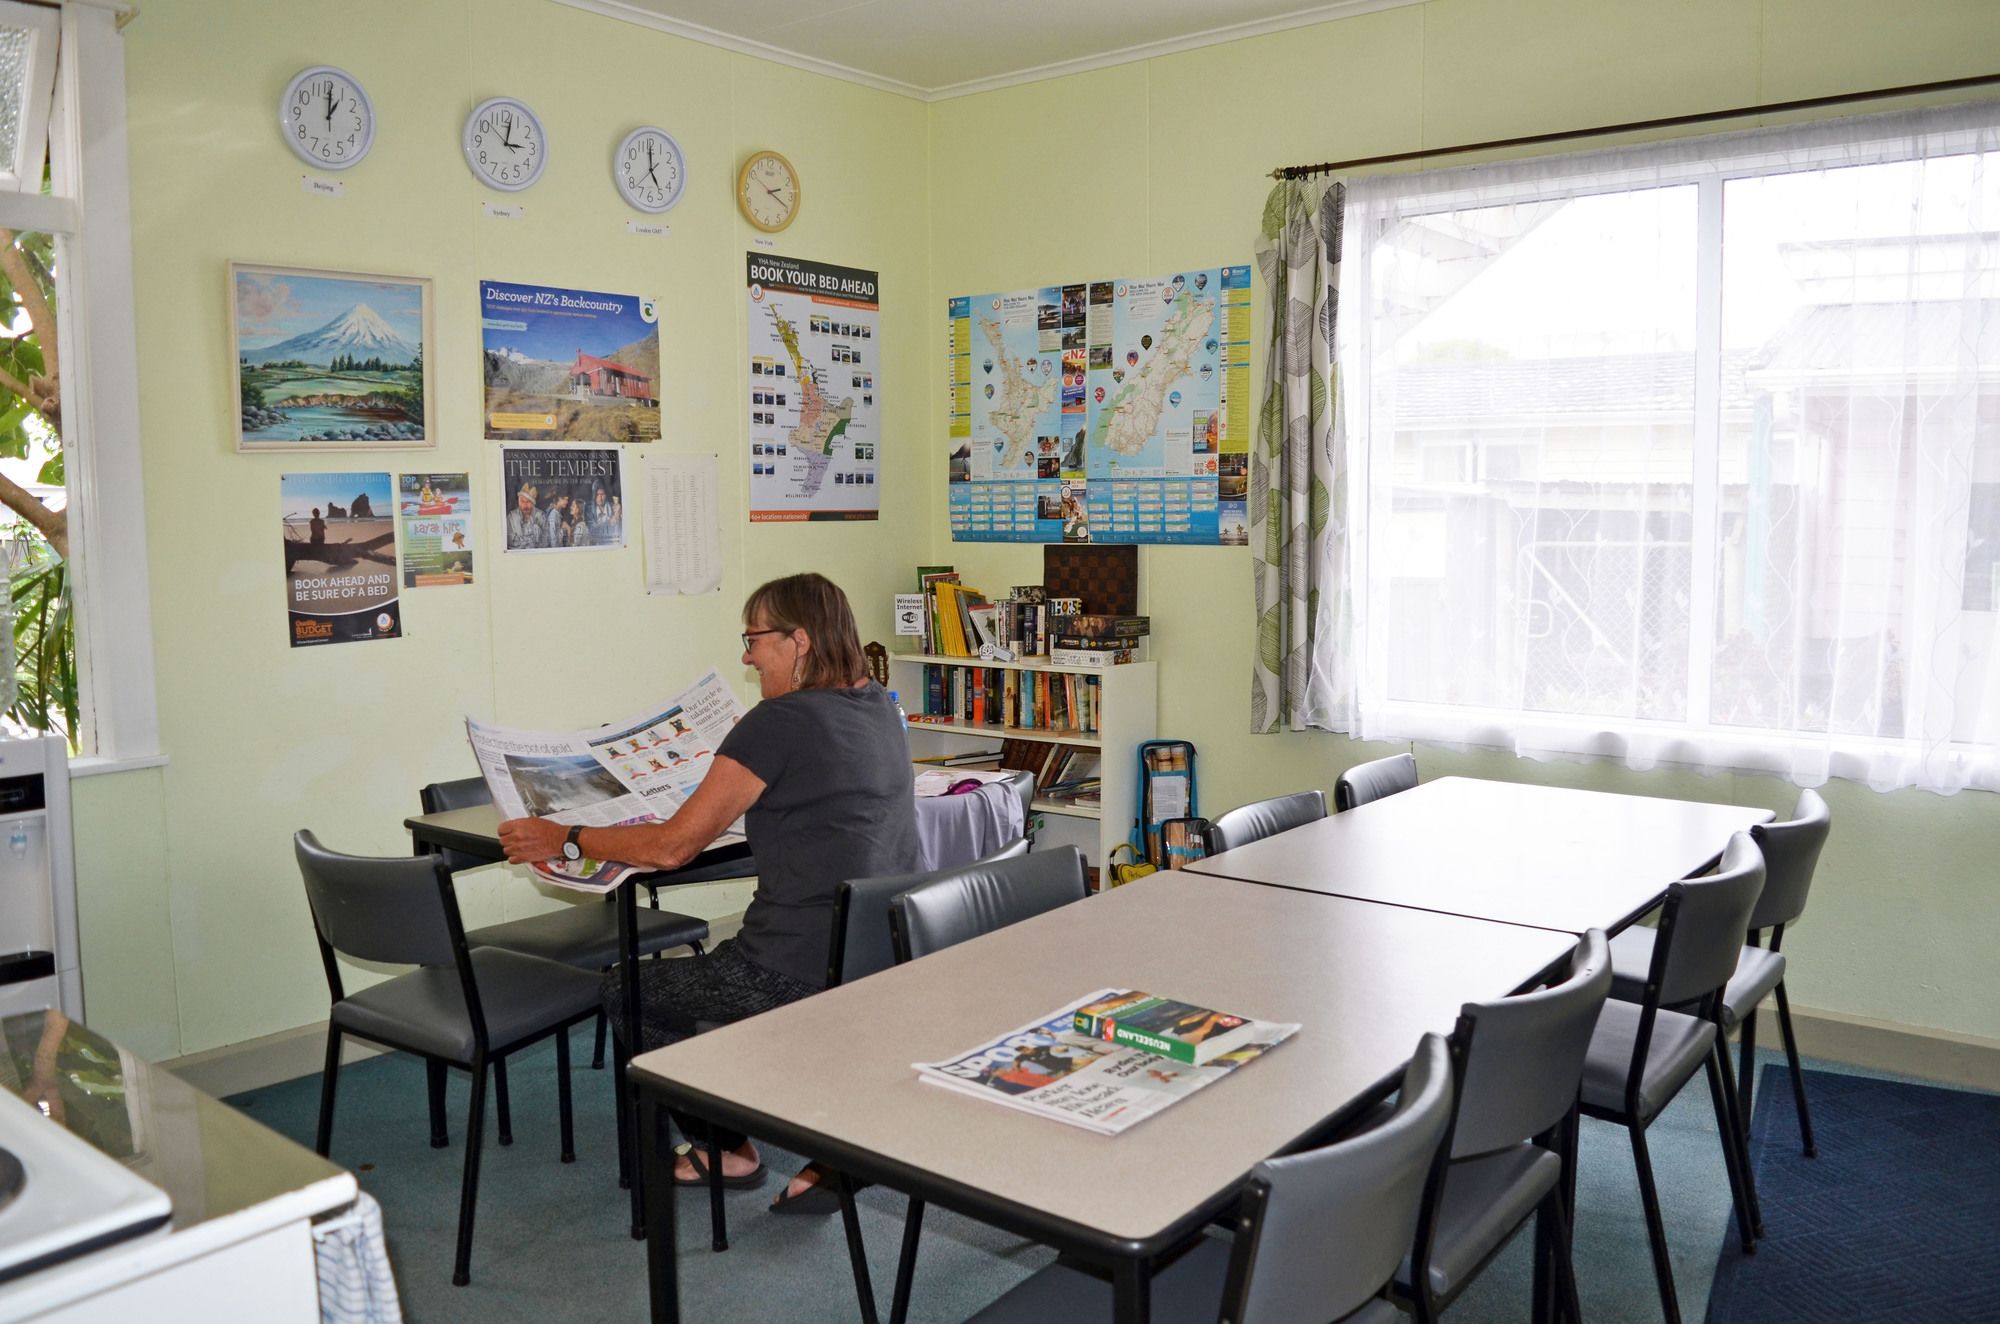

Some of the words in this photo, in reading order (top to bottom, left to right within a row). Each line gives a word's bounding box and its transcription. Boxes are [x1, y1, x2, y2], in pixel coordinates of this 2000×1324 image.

[313, 82, 320, 97] 11
[324, 80, 334, 96] 12
[299, 90, 310, 105] 10
[350, 98, 357, 113] 2
[293, 106, 302, 121] 9
[492, 112, 498, 126] 11
[502, 110, 511, 123] 12
[354, 116, 362, 131] 3
[480, 120, 490, 133] 10
[298, 124, 306, 139] 8
[524, 125, 531, 139] 2
[310, 137, 318, 152] 7
[347, 134, 354, 147] 4
[474, 135, 482, 148] 9
[638, 141, 644, 152] 11
[647, 138, 654, 152] 12
[322, 144, 330, 157] 6
[336, 141, 344, 156] 5
[529, 142, 536, 155] 3
[629, 148, 637, 160] 10
[480, 151, 486, 164] 8
[523, 158, 530, 170] 4
[666, 152, 672, 164] 2
[490, 162, 498, 175] 7
[501, 168, 508, 180] 6
[513, 165, 520, 178] 5
[625, 162, 631, 174] 9
[670, 167, 676, 180] 3
[629, 177, 635, 189] 8
[665, 181, 671, 192] 4
[638, 186, 644, 198] 7
[647, 190, 653, 202] 6
[657, 189, 664, 201] 5
[781, 261, 800, 270] Zealand
[751, 265, 784, 283] BOOK
[786, 270, 816, 287] YOUR
[820, 275, 838, 290] BED
[841, 279, 874, 295] AHEAD
[486, 288, 533, 303] Discover
[534, 293, 559, 306] NZ's
[560, 296, 623, 314] Backcountry
[1071, 349, 1085, 359] NZ
[506, 460, 540, 476] THE
[546, 460, 616, 476] TEMPEST
[295, 578, 327, 590] BOOK
[330, 576, 365, 587] AHEAD
[368, 574, 390, 585] AND
[296, 591, 310, 601] BE
[312, 589, 339, 600] SURE
[342, 588, 356, 597] OF
[358, 587, 365, 597] A
[368, 586, 388, 596] BED
[296, 624, 332, 634] BUDGET
[640, 783, 672, 797] Letters
[1117, 1028, 1171, 1051] NEUSEELAND
